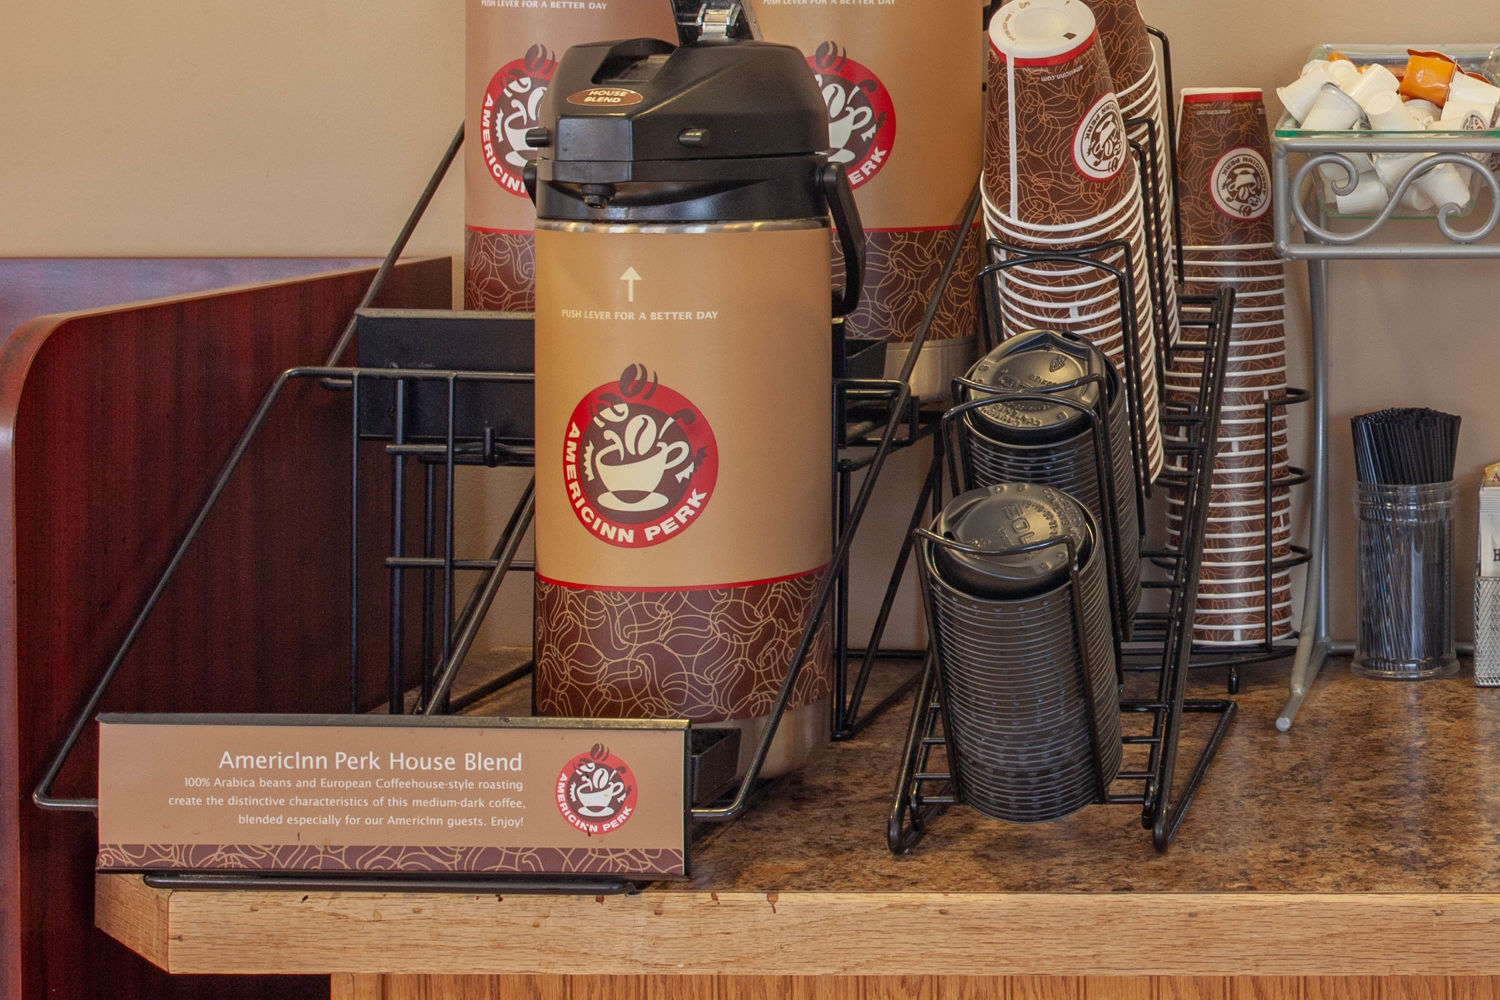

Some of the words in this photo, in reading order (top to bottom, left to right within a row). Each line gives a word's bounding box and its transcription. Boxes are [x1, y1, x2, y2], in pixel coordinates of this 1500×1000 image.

[481, 0, 496, 7] PUSH
[522, 0, 538, 8] FOR
[550, 1, 585, 9] BETTER
[589, 1, 607, 10] DAY
[1041, 64, 1084, 81] americinn.com
[848, 146, 887, 185] ERK
[561, 309, 582, 318] PUSH
[584, 310, 612, 320] LEVER
[614, 311, 636, 321] FOR
[638, 311, 648, 321] A
[650, 311, 693, 321] BETTER
[696, 310, 719, 320] DAY
[566, 421, 635, 543] AMERICINN
[644, 488, 707, 541] PERK
[218, 750, 328, 770] AmericInn
[335, 750, 382, 770] Perk
[389, 751, 456, 771] House
[464, 751, 522, 772] Blend
[184, 776, 211, 788] 100%
[213, 776, 256, 789] Arabica
[259, 776, 292, 788] beans
[295, 777, 317, 788] and
[320, 777, 372, 791] European
[375, 777, 475, 792] Coffeehouse-style
[478, 779, 524, 793] roasting
[168, 796, 203, 806] create
[206, 795, 224, 806] the
[227, 795, 286, 807] distinctive
[288, 795, 369, 807] characteristics
[372, 795, 385, 807] of
[387, 796, 409, 807] this
[412, 796, 485, 808] medium-dark
[488, 797, 526, 809] coffee,
[557, 772, 598, 832] AMERICINN
[602, 806, 632, 831] PERK
[238, 813, 283, 825] blended
[286, 814, 342, 828] especially
[344, 814, 362, 825] for
[364, 817, 384, 826] our
[387, 815, 444, 826] AmericInn
[446, 817, 487, 829] guests.
[490, 816, 524, 829] Enjoy!
